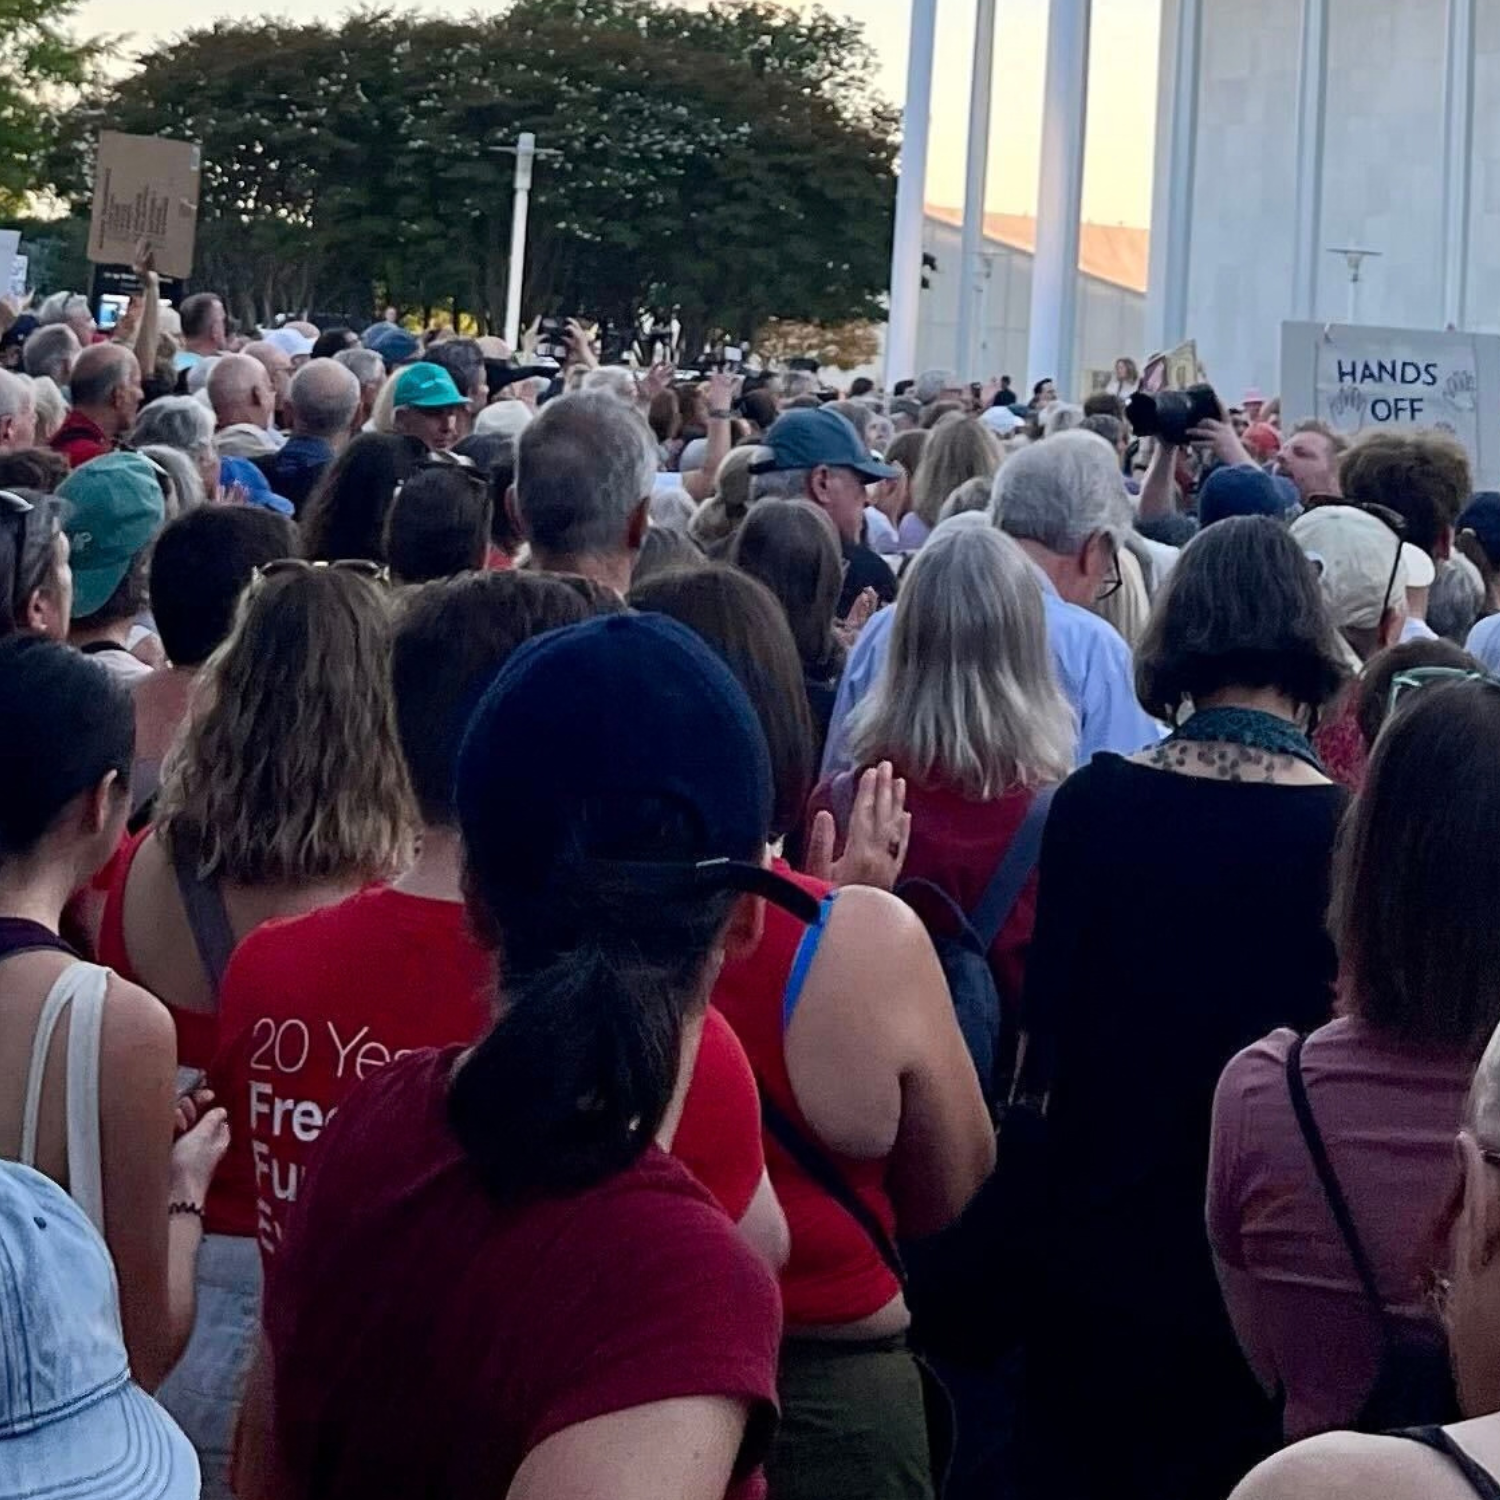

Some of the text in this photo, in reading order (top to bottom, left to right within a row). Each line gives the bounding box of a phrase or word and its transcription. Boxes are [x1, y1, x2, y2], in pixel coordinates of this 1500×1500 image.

[1338, 359, 1438, 386] HANDS
[1371, 398, 1424, 421] OFF
[250, 1018, 412, 1080] 20 Ye
[249, 1080, 339, 1141] Fre
[252, 1139, 306, 1201] Fu
